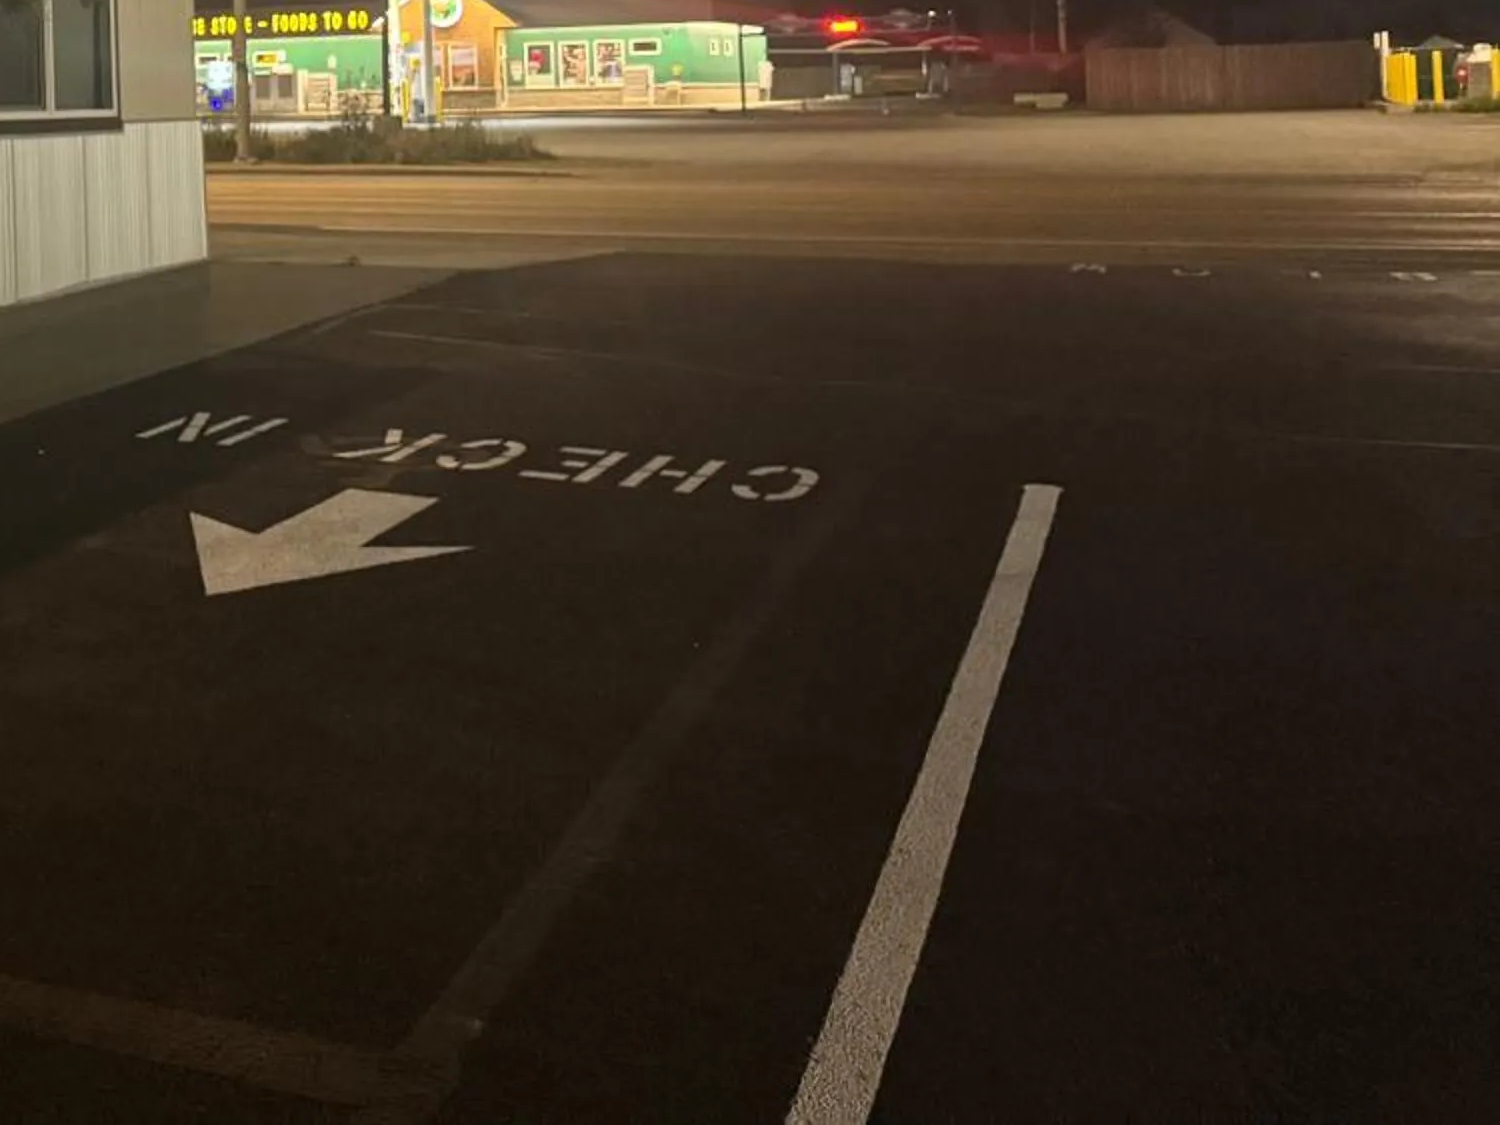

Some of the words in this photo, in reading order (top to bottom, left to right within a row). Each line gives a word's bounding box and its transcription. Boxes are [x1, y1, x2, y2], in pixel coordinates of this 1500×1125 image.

[210, 15, 253, 35] STOE
[271, 12, 318, 33] FOODS
[323, 11, 343, 31] TO
[347, 10, 369, 30] GO
[135, 411, 289, 447] IN
[333, 428, 820, 502] CHECK
